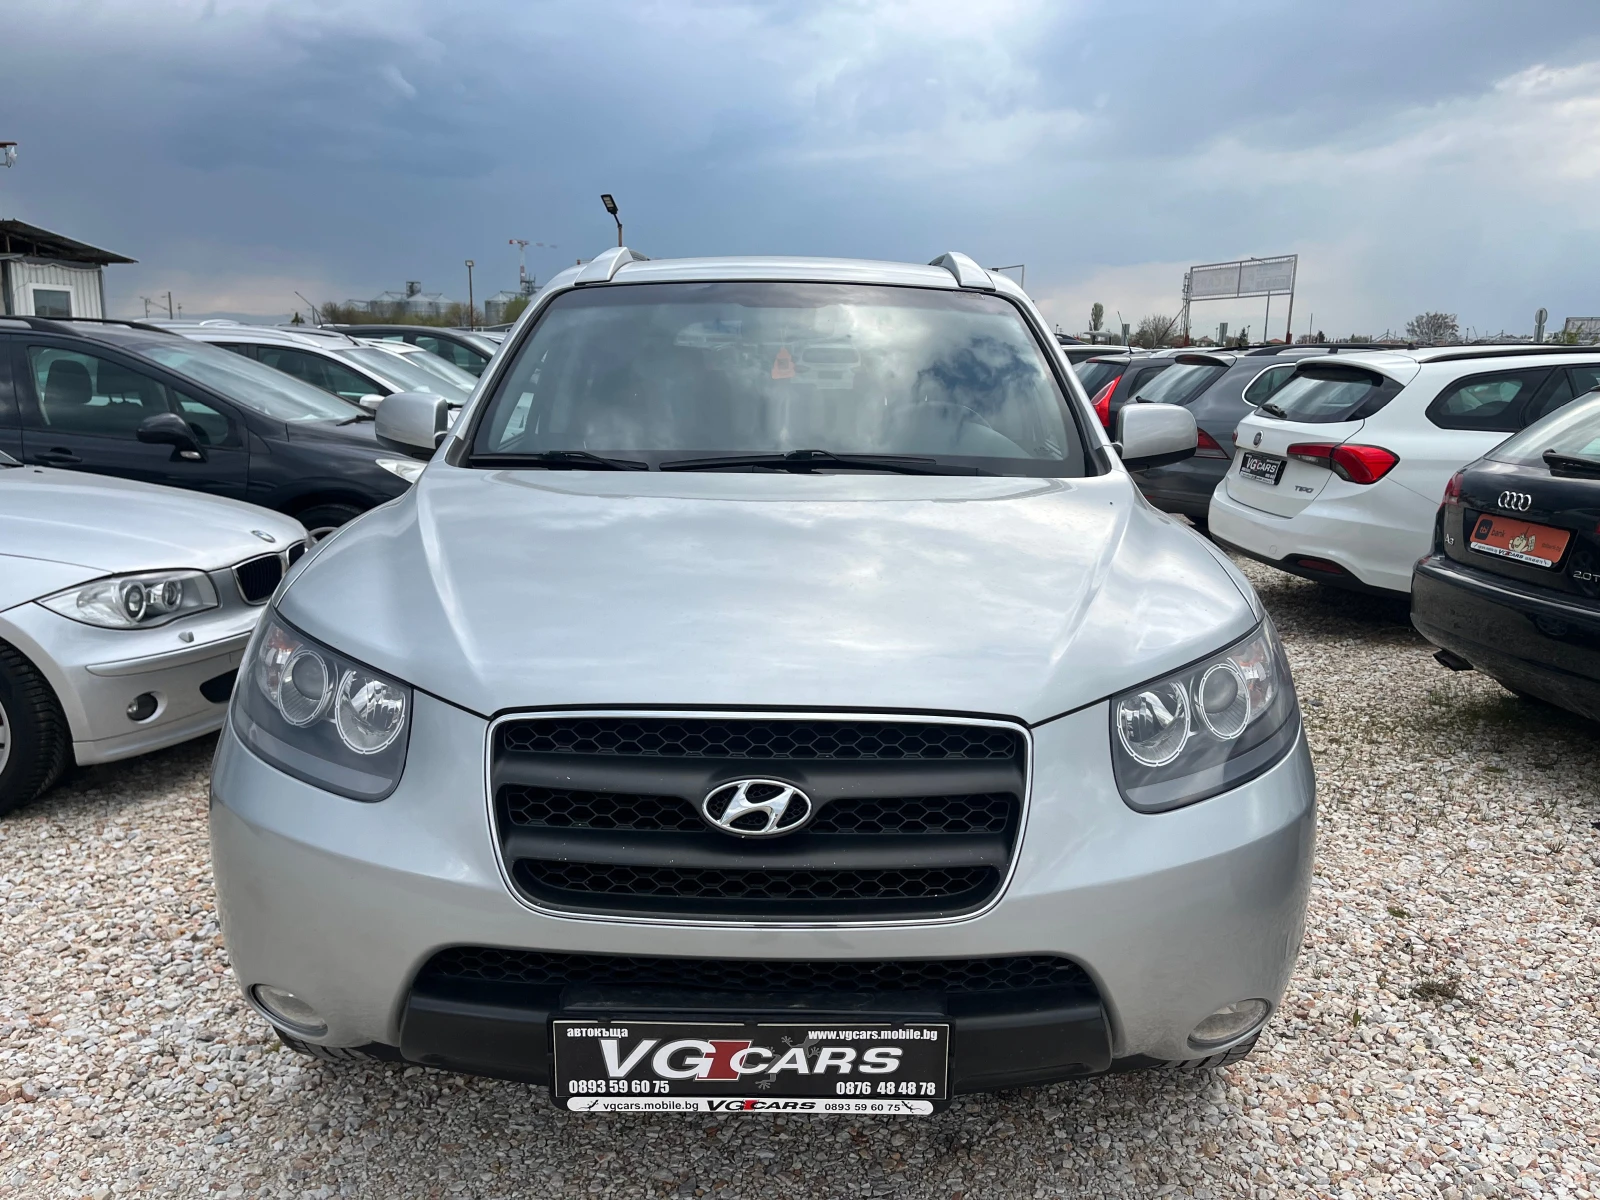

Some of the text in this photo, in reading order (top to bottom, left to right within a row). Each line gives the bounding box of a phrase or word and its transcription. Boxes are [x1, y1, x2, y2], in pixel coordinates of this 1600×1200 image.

[1445, 533, 1454, 545] A3
[1491, 529, 1505, 537] bank
[567, 1028, 629, 1039] автокъща
[808, 1029, 938, 1041] www.vgcars.mobile.bg
[568, 1080, 670, 1094] 0893 59 60 75
[836, 1081, 936, 1096] 0876 48 48 78
[603, 1101, 699, 1112] vgcars.mobile.bg
[824, 1103, 851, 1112] 0893
[854, 1103, 867, 1112] 59
[870, 1103, 884, 1112] 60
[887, 1103, 901, 1112] 75
